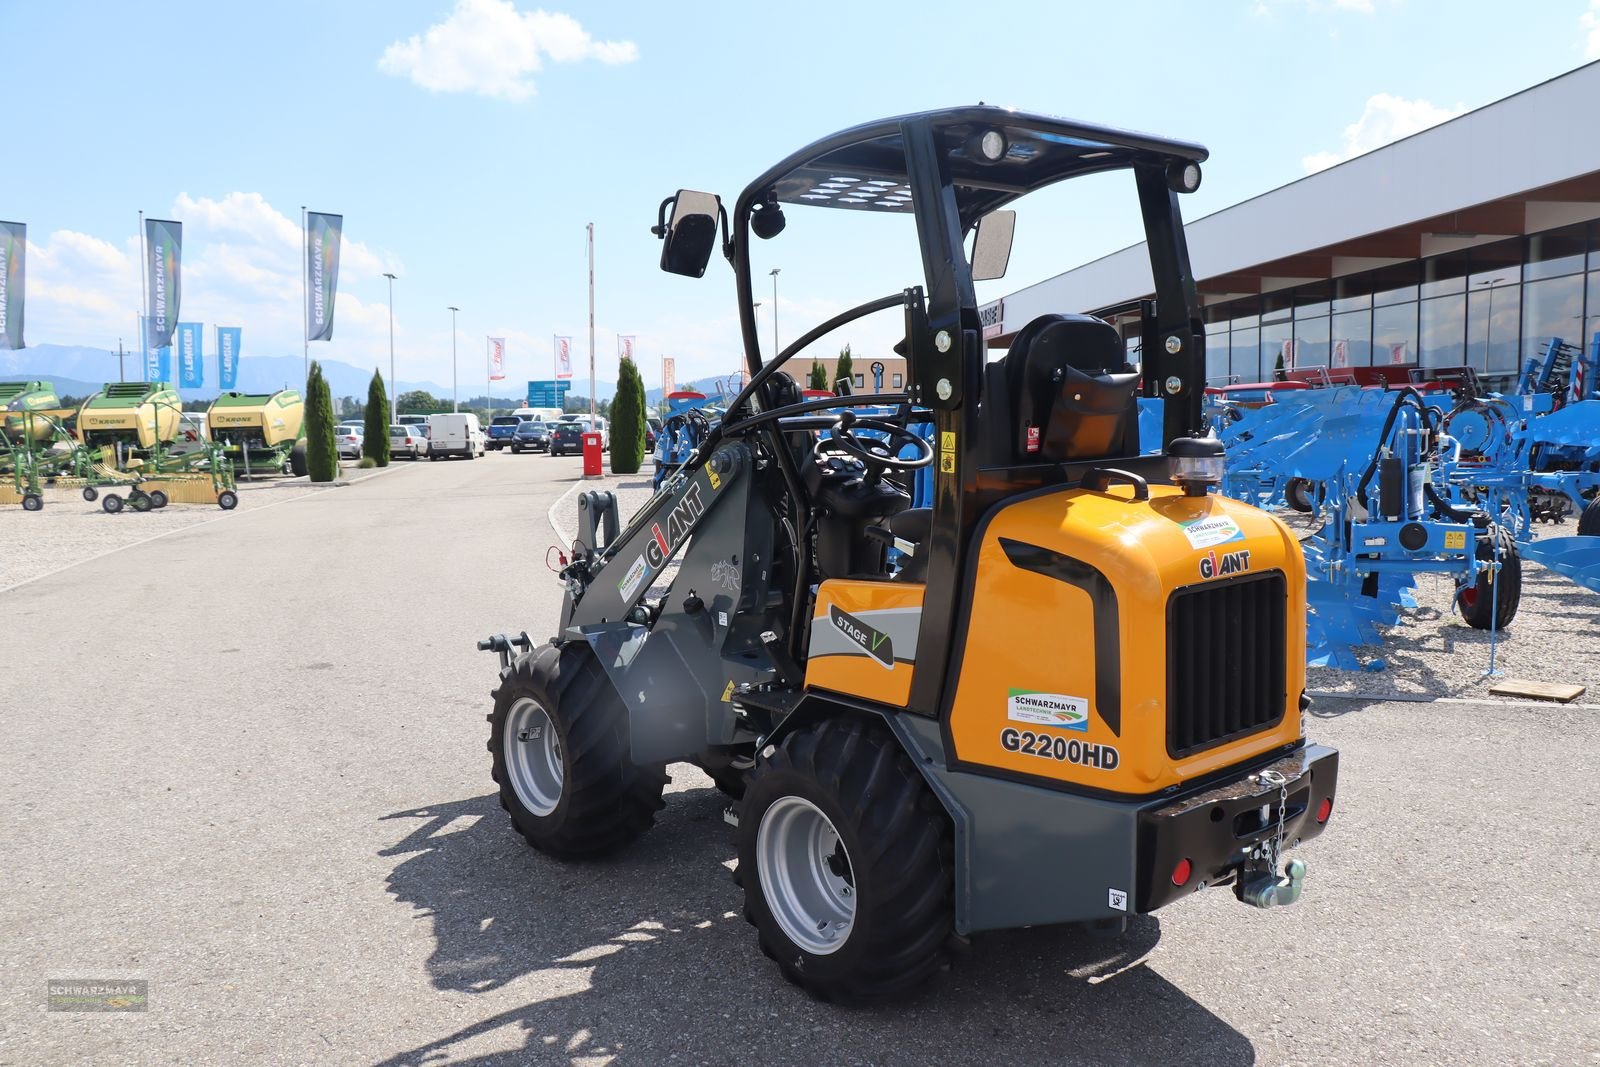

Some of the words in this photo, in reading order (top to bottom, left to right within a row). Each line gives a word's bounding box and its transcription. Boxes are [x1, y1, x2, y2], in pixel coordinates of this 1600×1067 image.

[155, 245, 166, 332] SCHWARZMAYR
[314, 238, 324, 325] SCHWARZMAYR
[183, 328, 195, 371] LEMKEN
[223, 332, 233, 373] LEMKEN
[1187, 520, 1230, 534] SCHWARZMAYR
[837, 616, 868, 645] STAGE
[1015, 696, 1077, 712] SCHWARZMAYR
[1000, 727, 1120, 771] G2200HD
